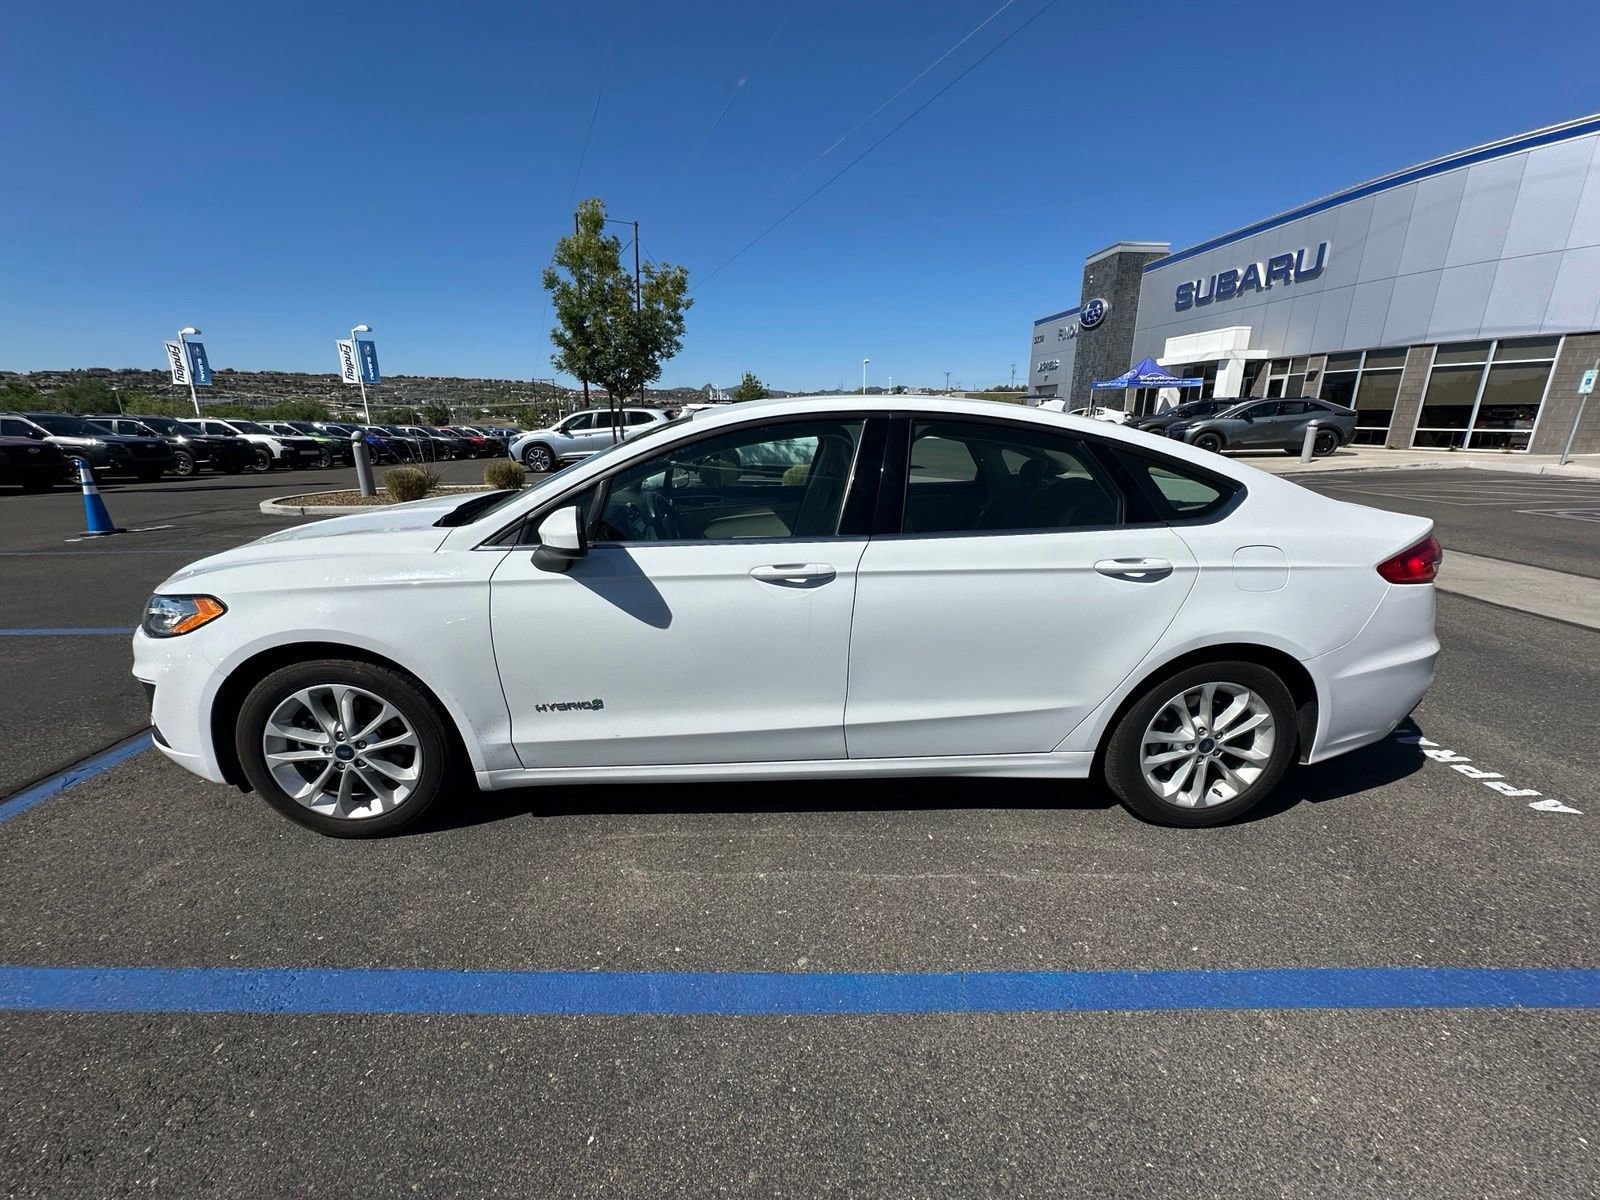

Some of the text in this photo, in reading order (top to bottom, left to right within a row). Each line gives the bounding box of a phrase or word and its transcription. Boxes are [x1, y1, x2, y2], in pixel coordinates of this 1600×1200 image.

[1175, 242, 1329, 312] SUBARU
[166, 343, 185, 383] Findlay
[338, 342, 355, 381] Findlay
[535, 701, 592, 713] HYBRID
